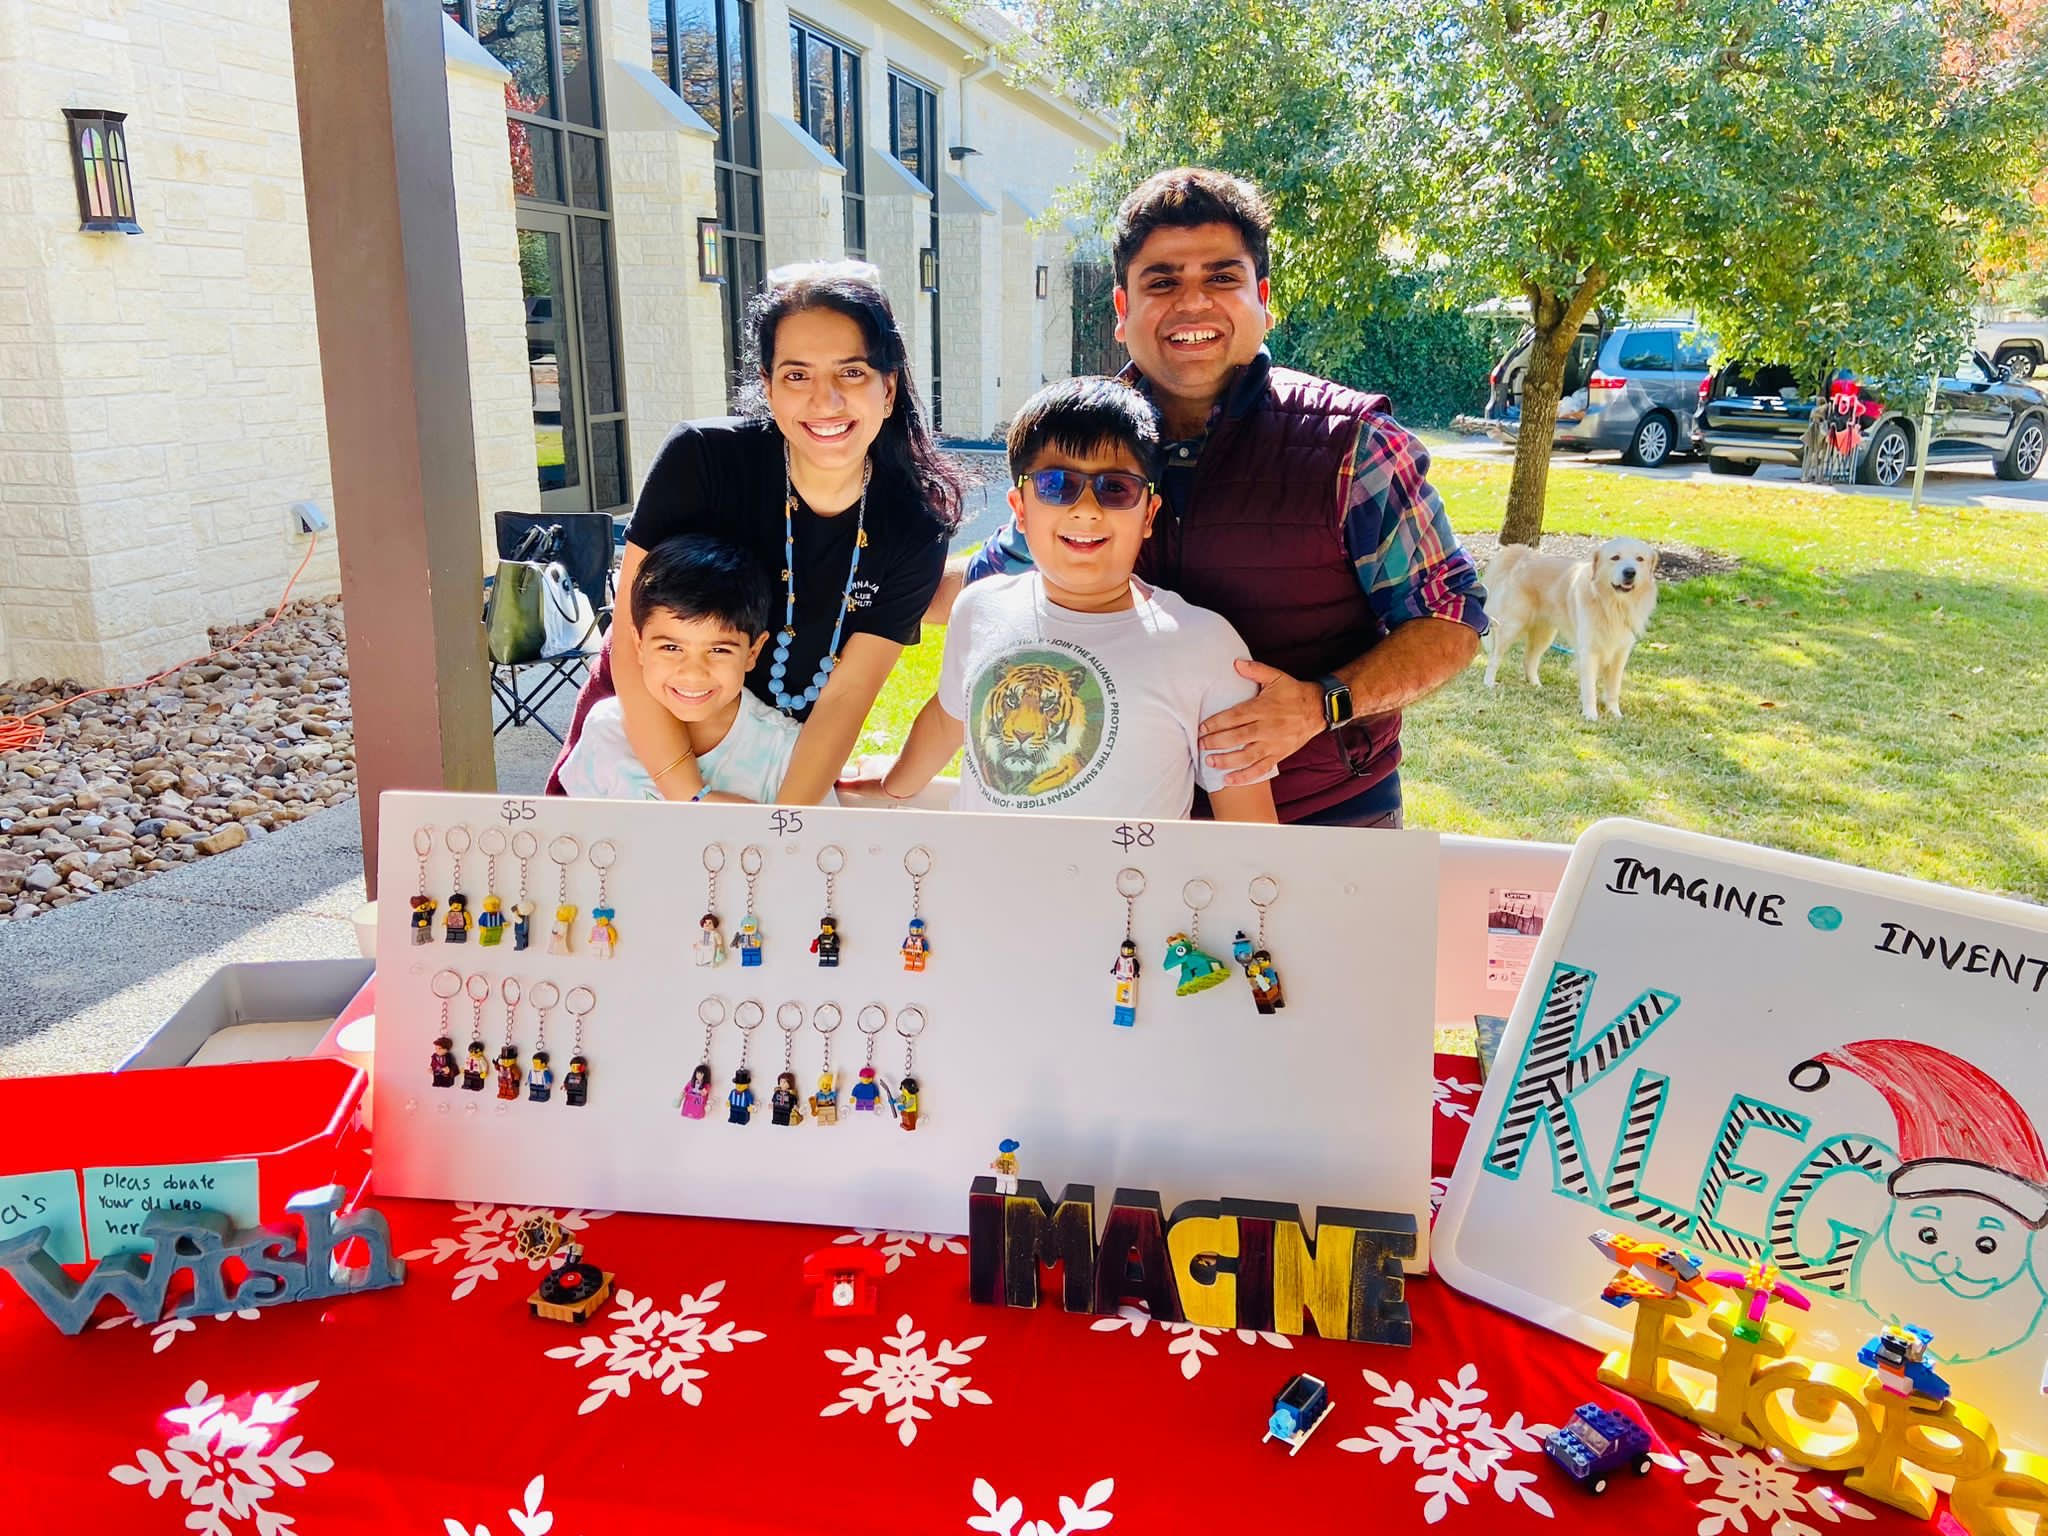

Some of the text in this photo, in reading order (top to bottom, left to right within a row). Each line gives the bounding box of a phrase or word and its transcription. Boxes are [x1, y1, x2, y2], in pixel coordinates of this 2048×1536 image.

[1051, 638, 1073, 649] JOIN
[1071, 644, 1091, 659] THE
[1088, 656, 1117, 696] ALLIANCE
[1017, 702, 1120, 809] PROTECT THE SUMATRAN TIGER
[501, 800, 537, 826] $5
[768, 809, 803, 837] $5
[1112, 822, 1155, 853] $8
[1605, 857, 2048, 992] IMAGINE INVENT
[163, 1174, 215, 1190] donate
[105, 1219, 140, 1235] her
[970, 1176, 1418, 1348] IMAGINE
